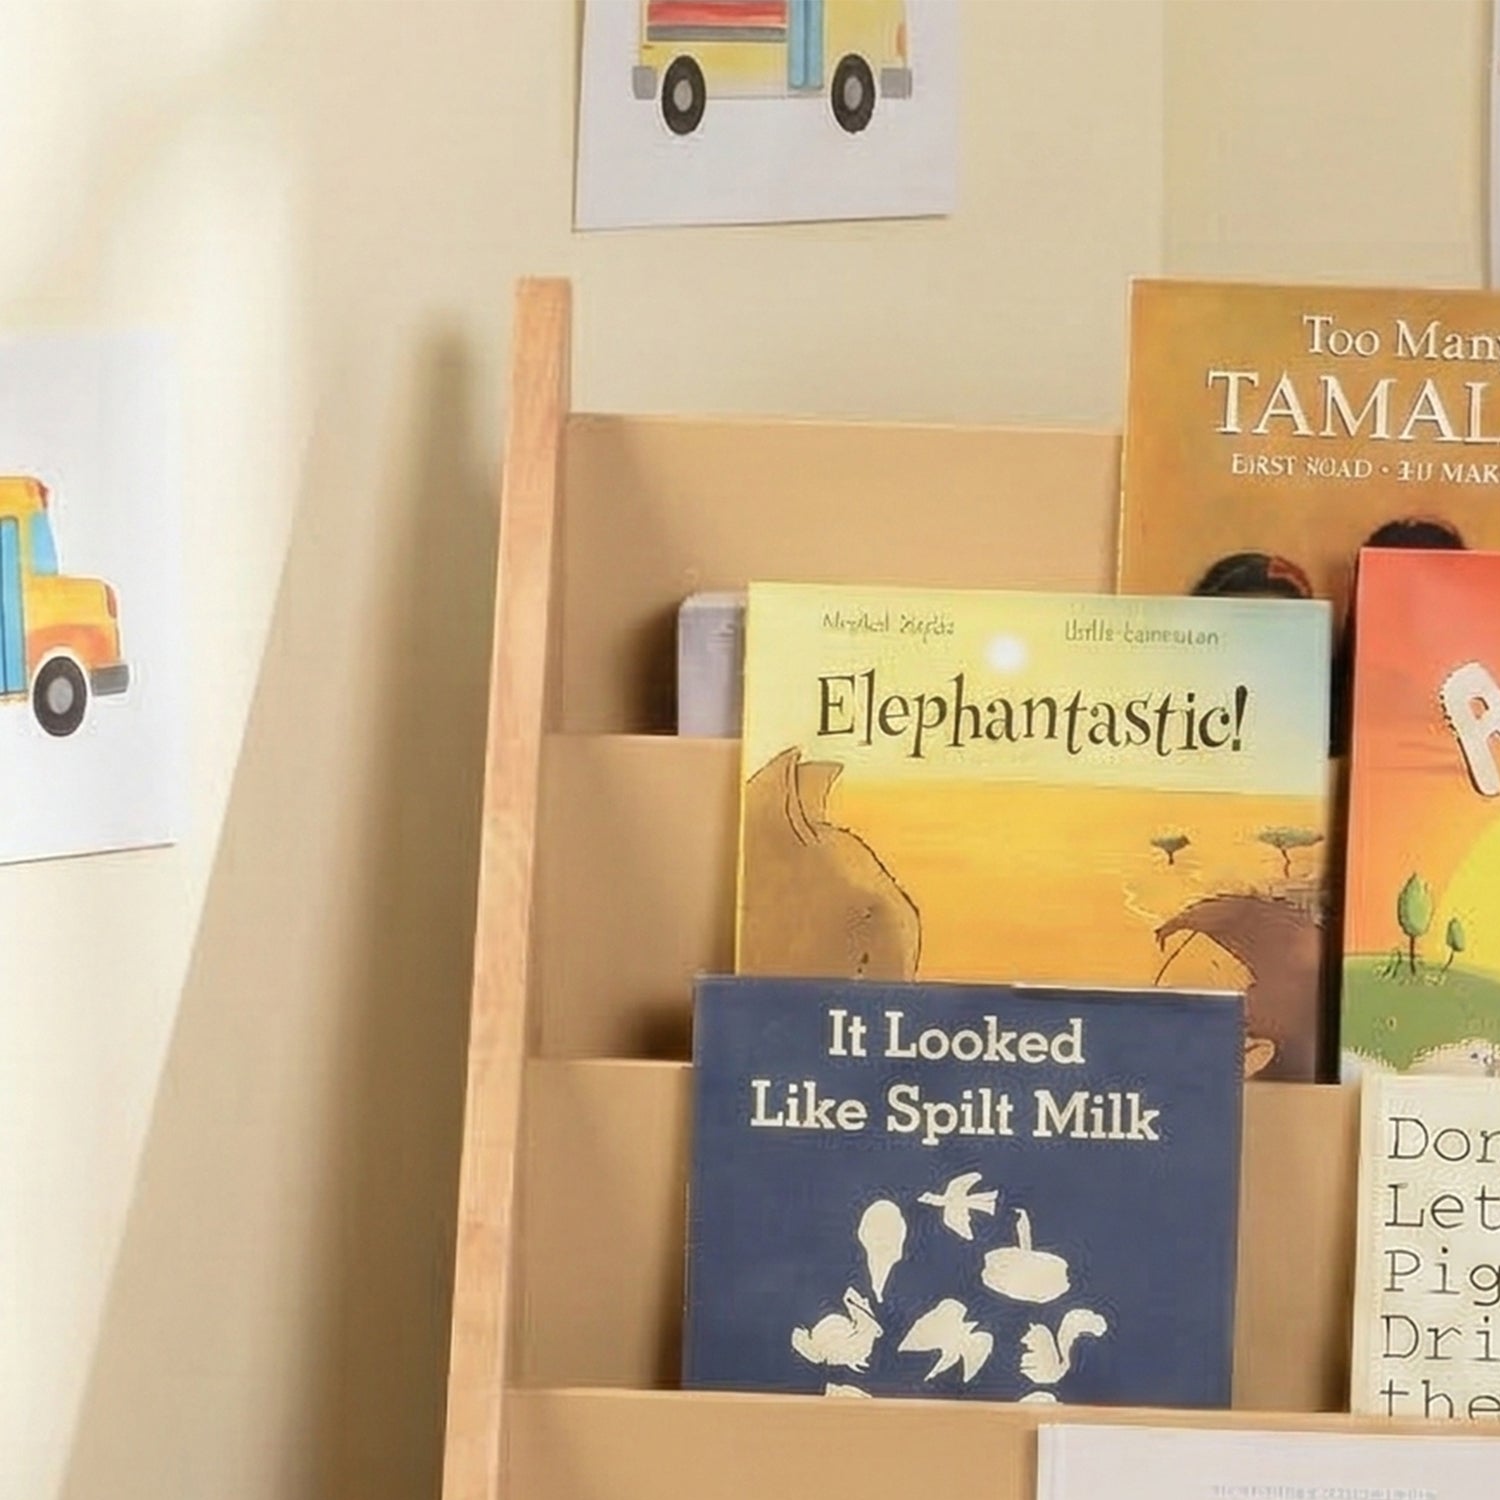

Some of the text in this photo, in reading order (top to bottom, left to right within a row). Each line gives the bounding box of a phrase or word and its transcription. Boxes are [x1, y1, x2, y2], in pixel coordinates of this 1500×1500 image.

[1303, 315, 1380, 358] Too
[817, 668, 1248, 758] Elephantastic!
[828, 1010, 1086, 1065] It Looked
[750, 1079, 1160, 1146] Like Spilt Milk
